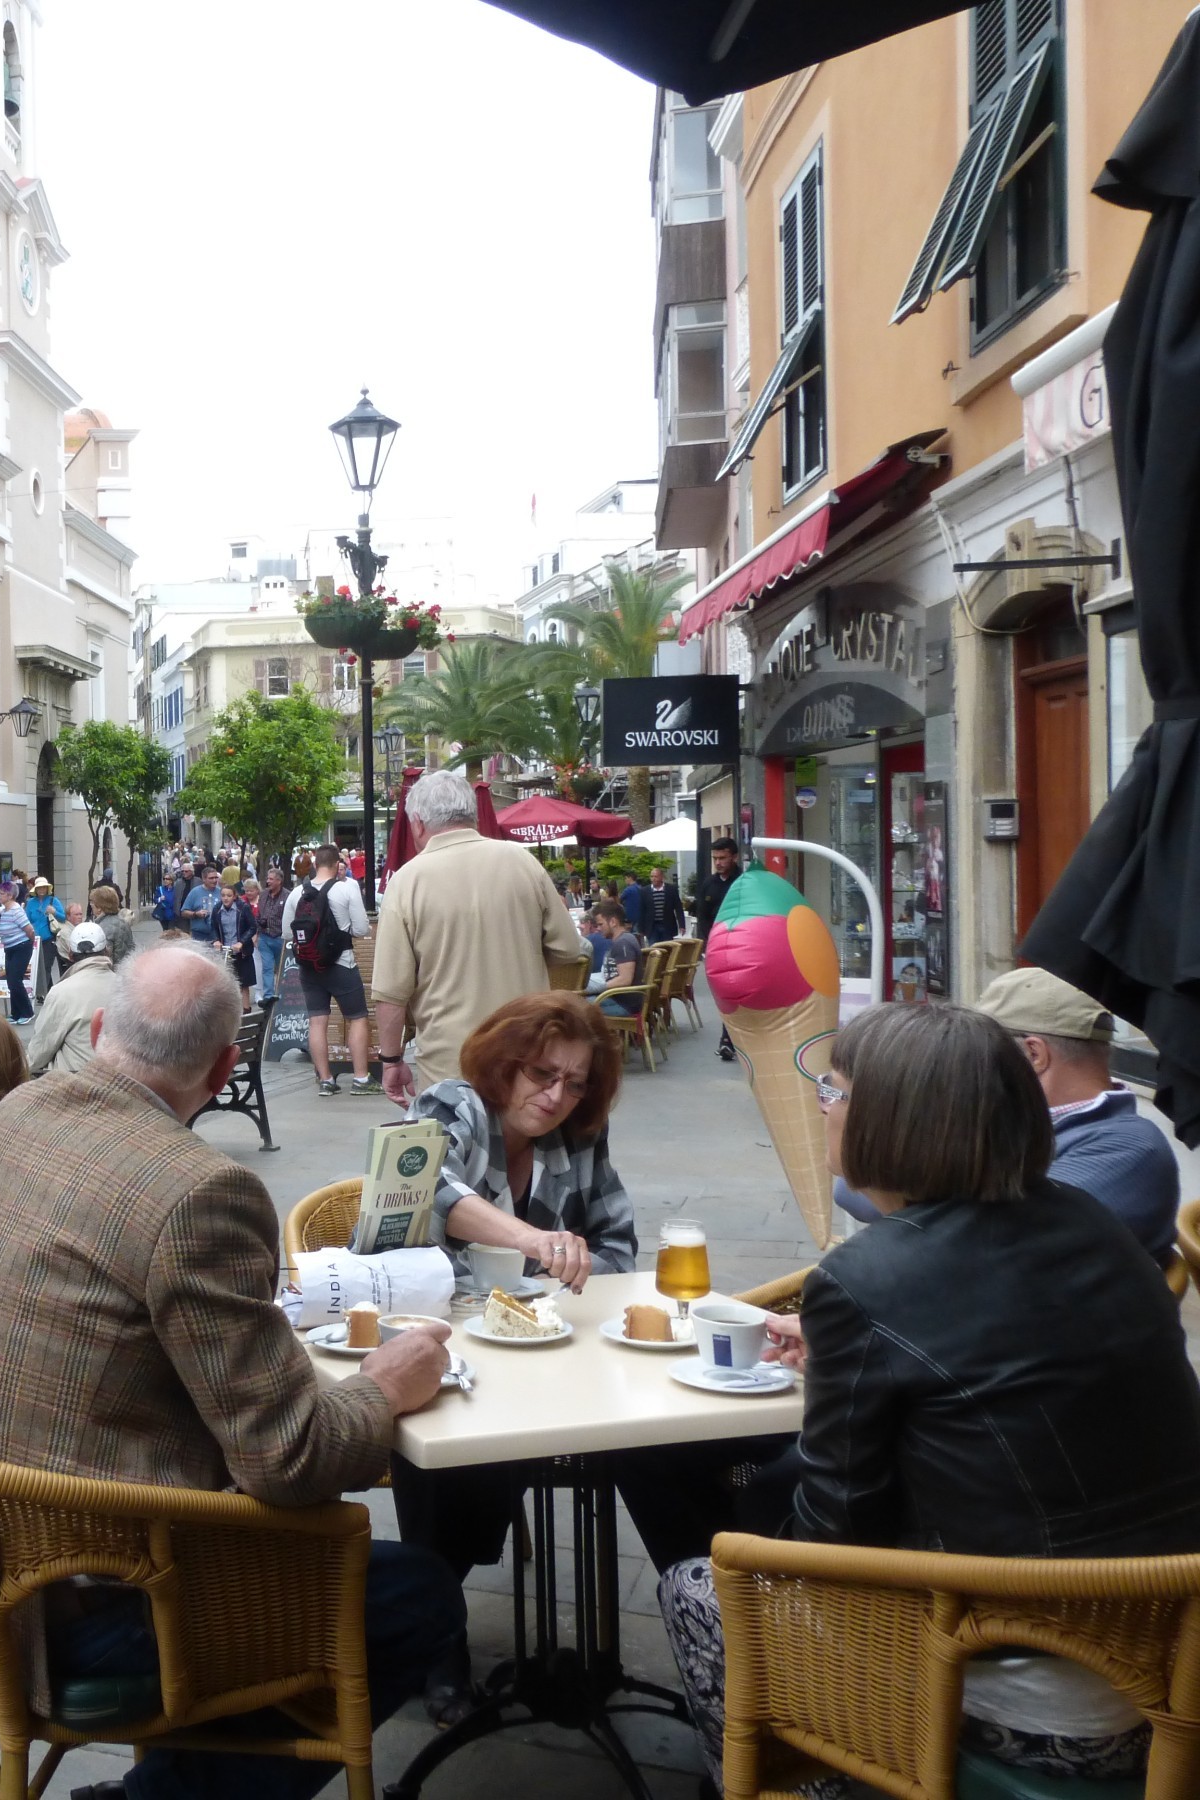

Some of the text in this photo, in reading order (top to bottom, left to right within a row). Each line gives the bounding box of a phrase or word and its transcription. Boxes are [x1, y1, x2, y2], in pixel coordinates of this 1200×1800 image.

[625, 730, 719, 747] SWAROVSKI
[510, 823, 569, 837] GIBRALTAR
[400, 1183, 412, 1191] The
[383, 1190, 422, 1209] DRINKS
[327, 1262, 341, 1314] INDIA
